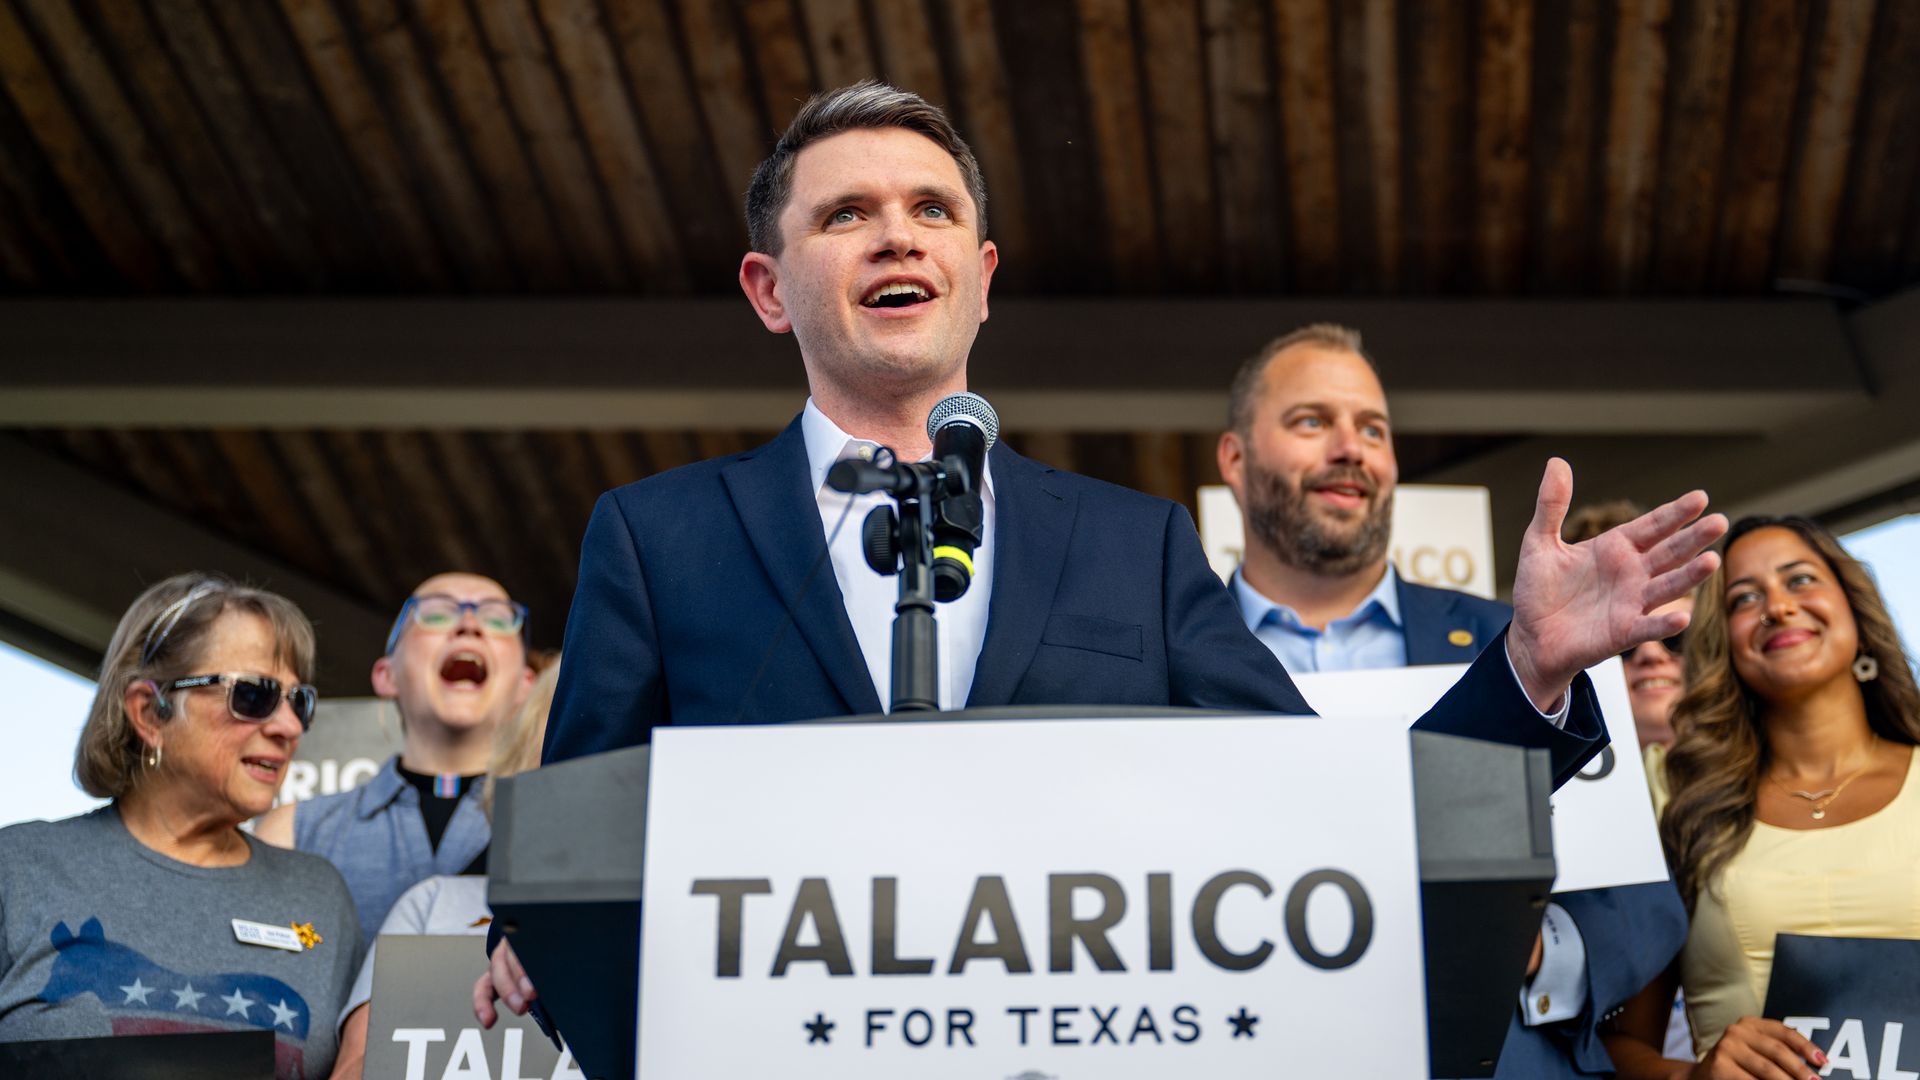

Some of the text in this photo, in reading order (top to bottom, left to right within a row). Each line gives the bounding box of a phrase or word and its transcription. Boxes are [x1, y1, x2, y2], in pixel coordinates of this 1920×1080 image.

[690, 868, 1376, 979] TALARICO
[865, 1004, 1203, 1048] FOR TEXAS
